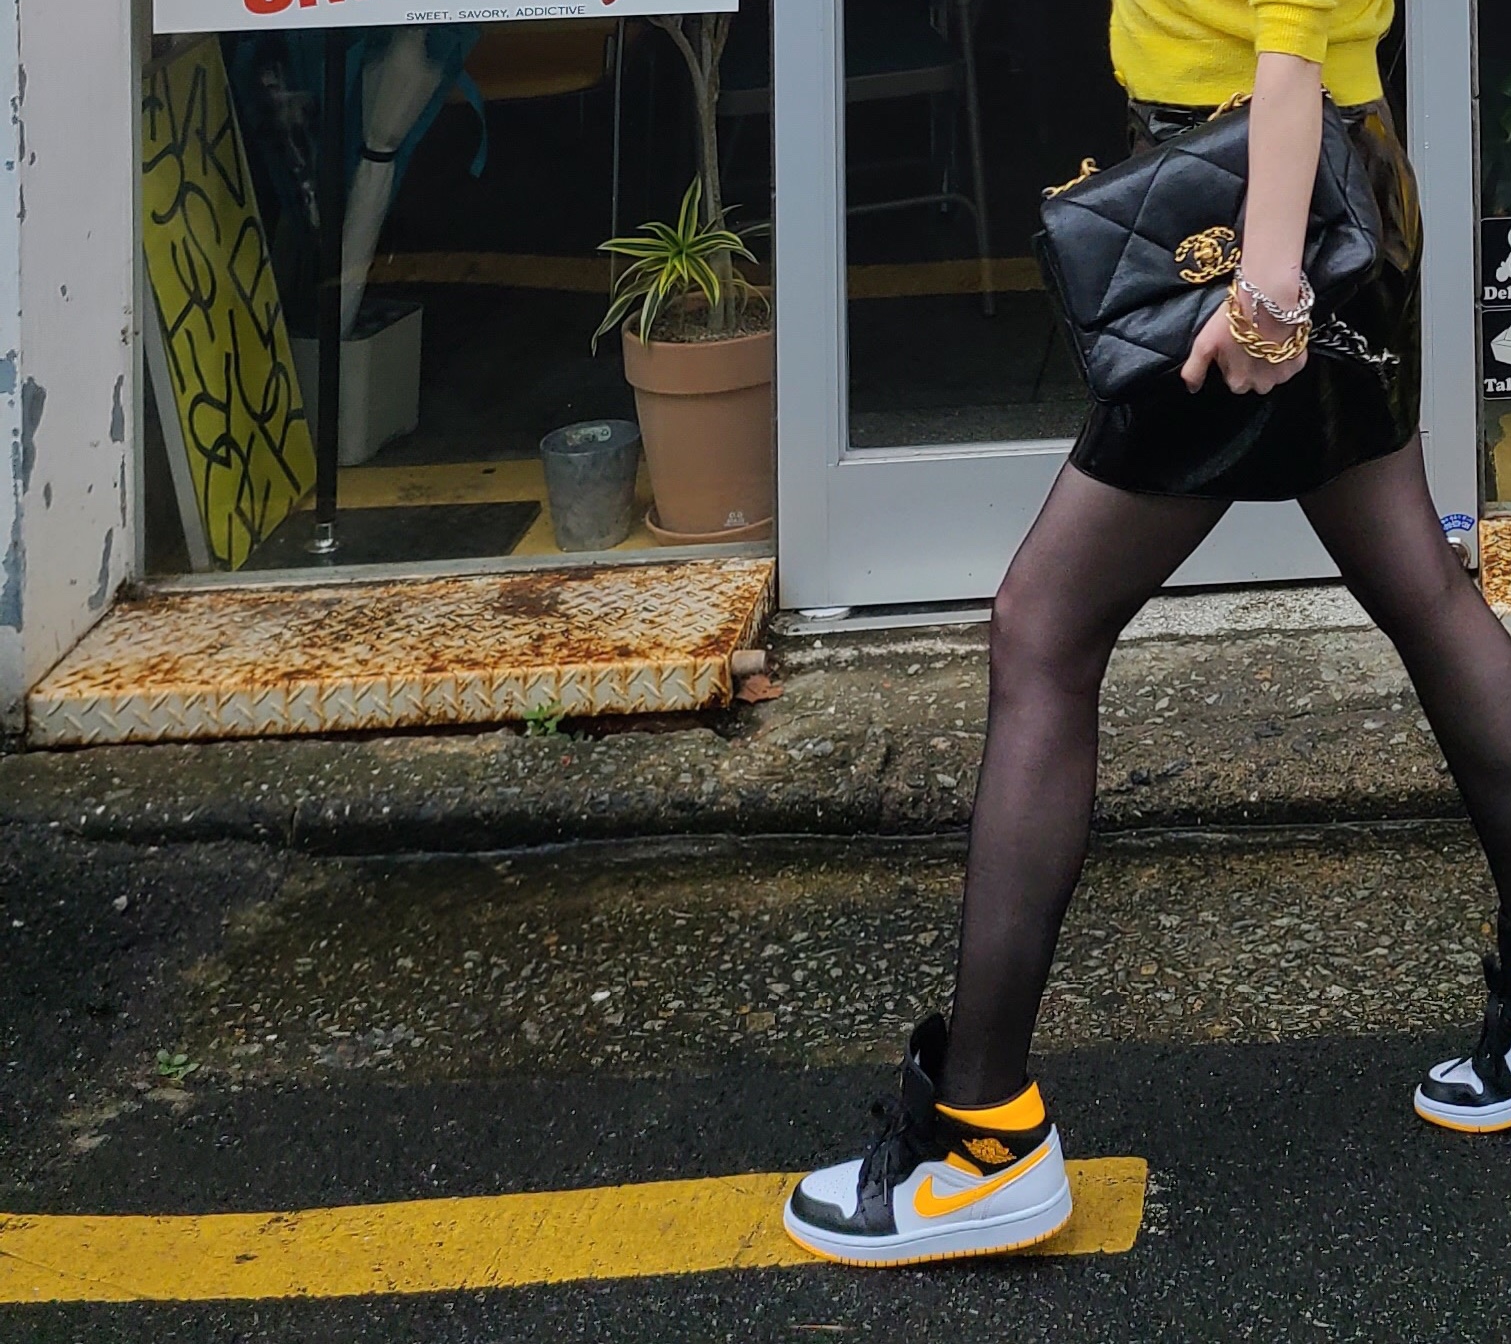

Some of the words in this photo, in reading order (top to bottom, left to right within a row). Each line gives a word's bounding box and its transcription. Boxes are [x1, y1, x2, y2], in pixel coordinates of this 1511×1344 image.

[406, 11, 454, 22] SWEET,
[459, 9, 510, 20] SAVORY,
[515, 6, 586, 17] ADDICTIVE
